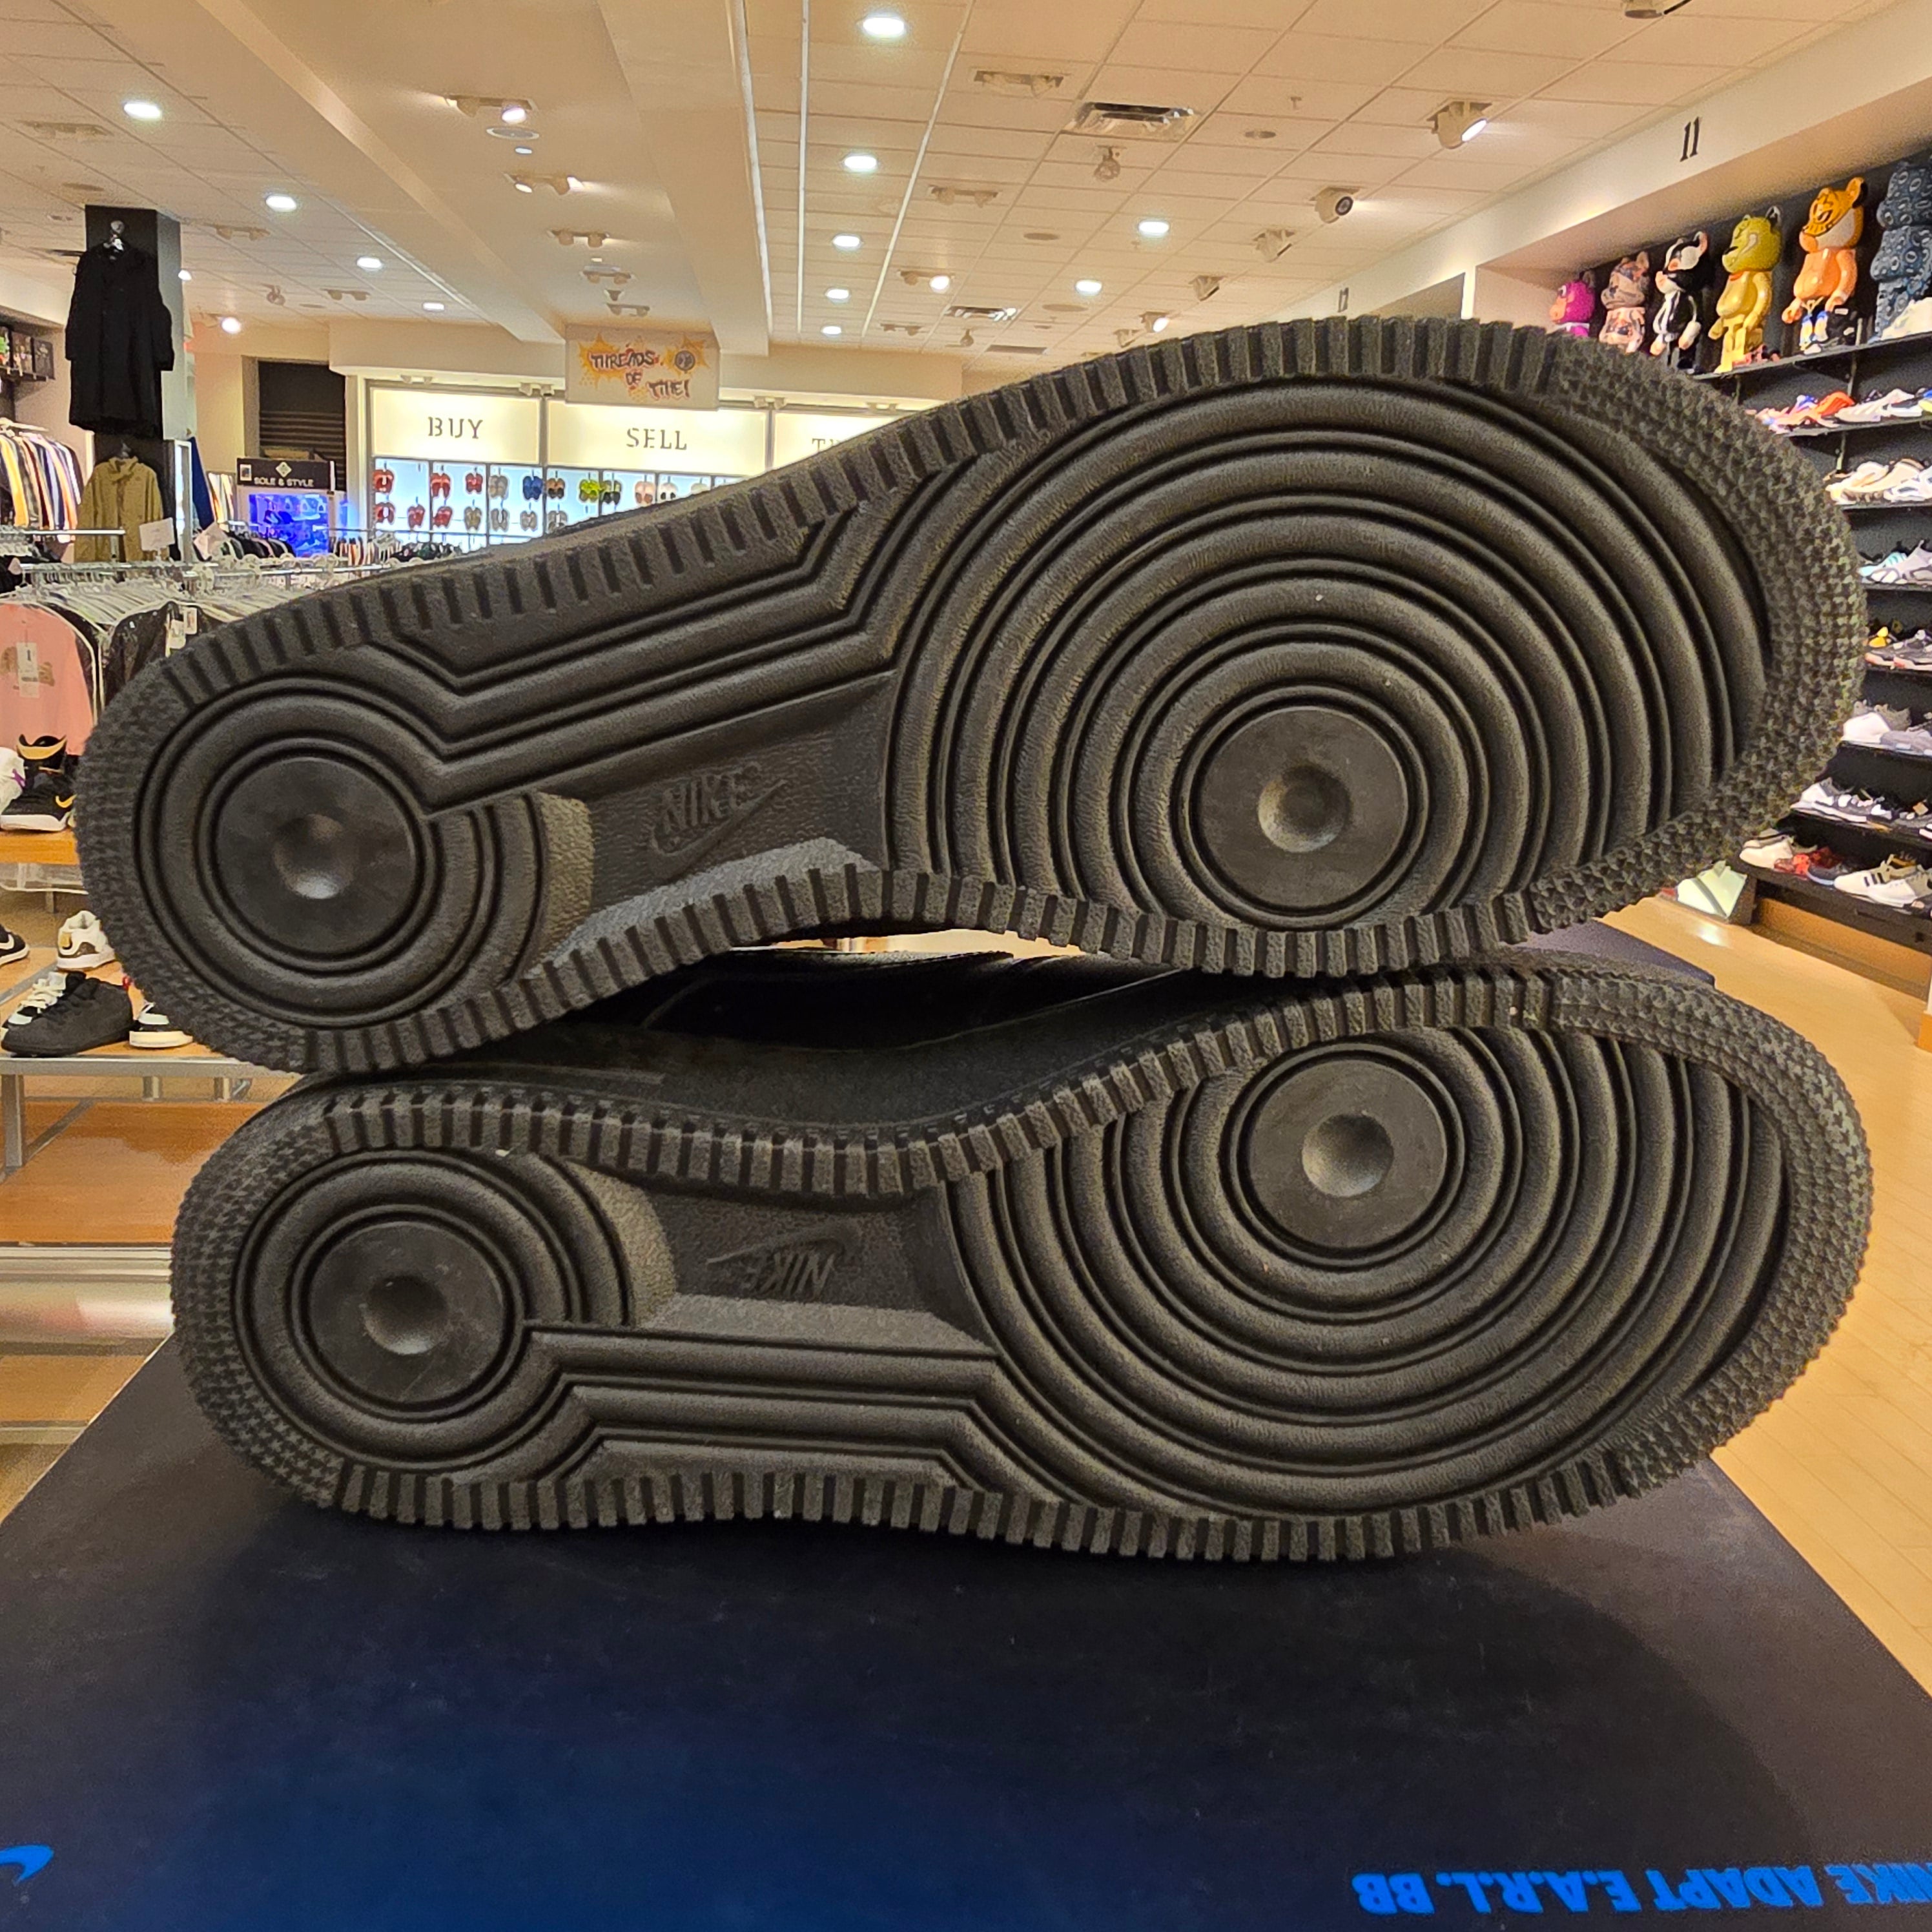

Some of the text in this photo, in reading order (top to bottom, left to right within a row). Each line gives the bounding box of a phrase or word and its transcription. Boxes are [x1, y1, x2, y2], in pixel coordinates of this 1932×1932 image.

[1680, 116, 1700, 162] 11
[590, 349, 656, 369] THREADS
[625, 371, 642, 386] OF
[428, 416, 483, 439] BUY
[626, 427, 687, 450] SELL
[254, 477, 314, 488] SOLE & STYLE
[662, 760, 763, 834] NIKE
[1351, 1873, 1435, 1915] BB
[1436, 1870, 1642, 1914] E.A.R.L.
[1646, 1865, 1824, 1911] ADAPT
